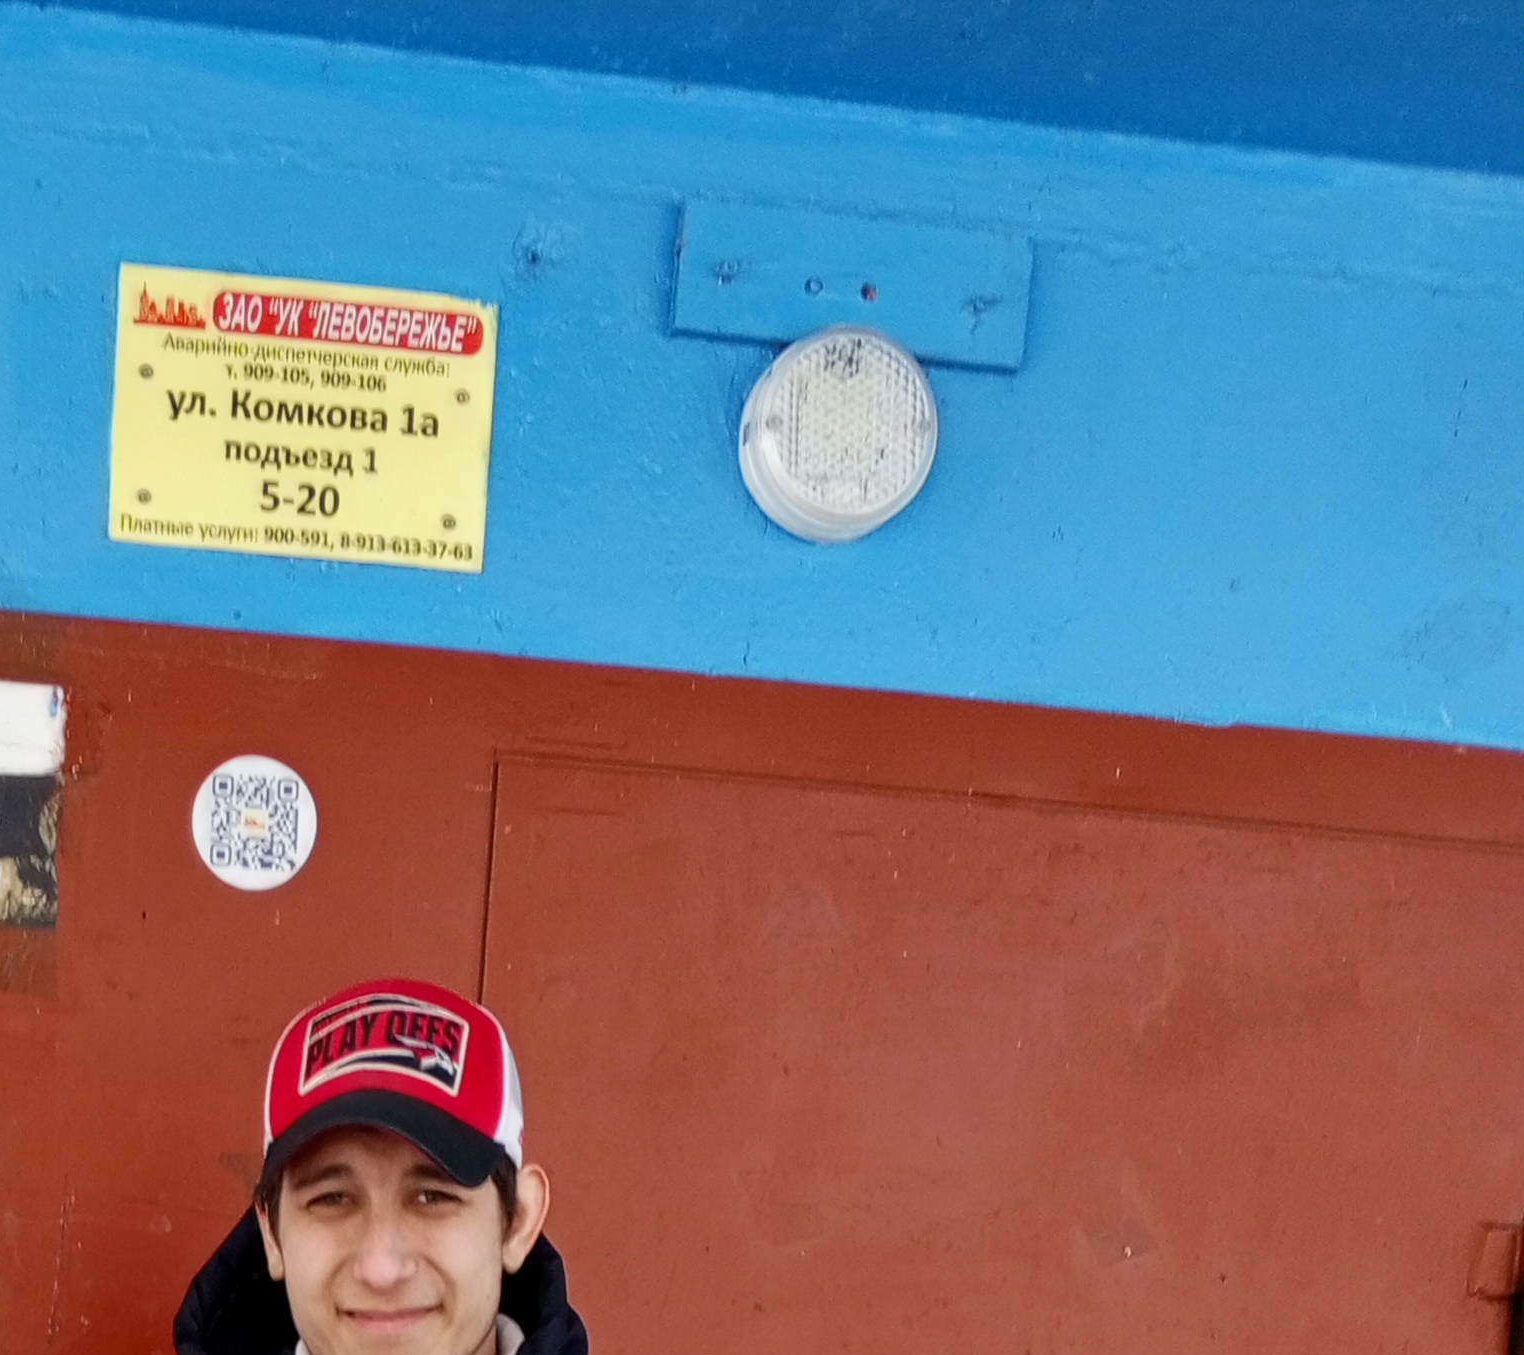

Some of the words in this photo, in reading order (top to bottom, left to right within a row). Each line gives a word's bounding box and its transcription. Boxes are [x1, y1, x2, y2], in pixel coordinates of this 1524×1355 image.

[219, 291, 263, 333] ЗАО
[161, 333, 378, 371] Аварийно-диспетчерская
[384, 355, 450, 378] служба:
[225, 363, 237, 380] т.
[242, 363, 315, 388] 909-105,
[320, 370, 387, 392] 909-106
[166, 390, 217, 420] ул.
[230, 388, 388, 433] Комкова
[399, 404, 440, 438] 1а
[224, 439, 354, 476] подъезд
[363, 448, 378, 474] 1
[259, 480, 341, 517] 5-20
[119, 514, 194, 537] Платные
[199, 524, 259, 544] услуги:
[263, 526, 334, 552] 900-591,
[304, 1010, 380, 1082] PLAY
[385, 1010, 461, 1057] OFFS
